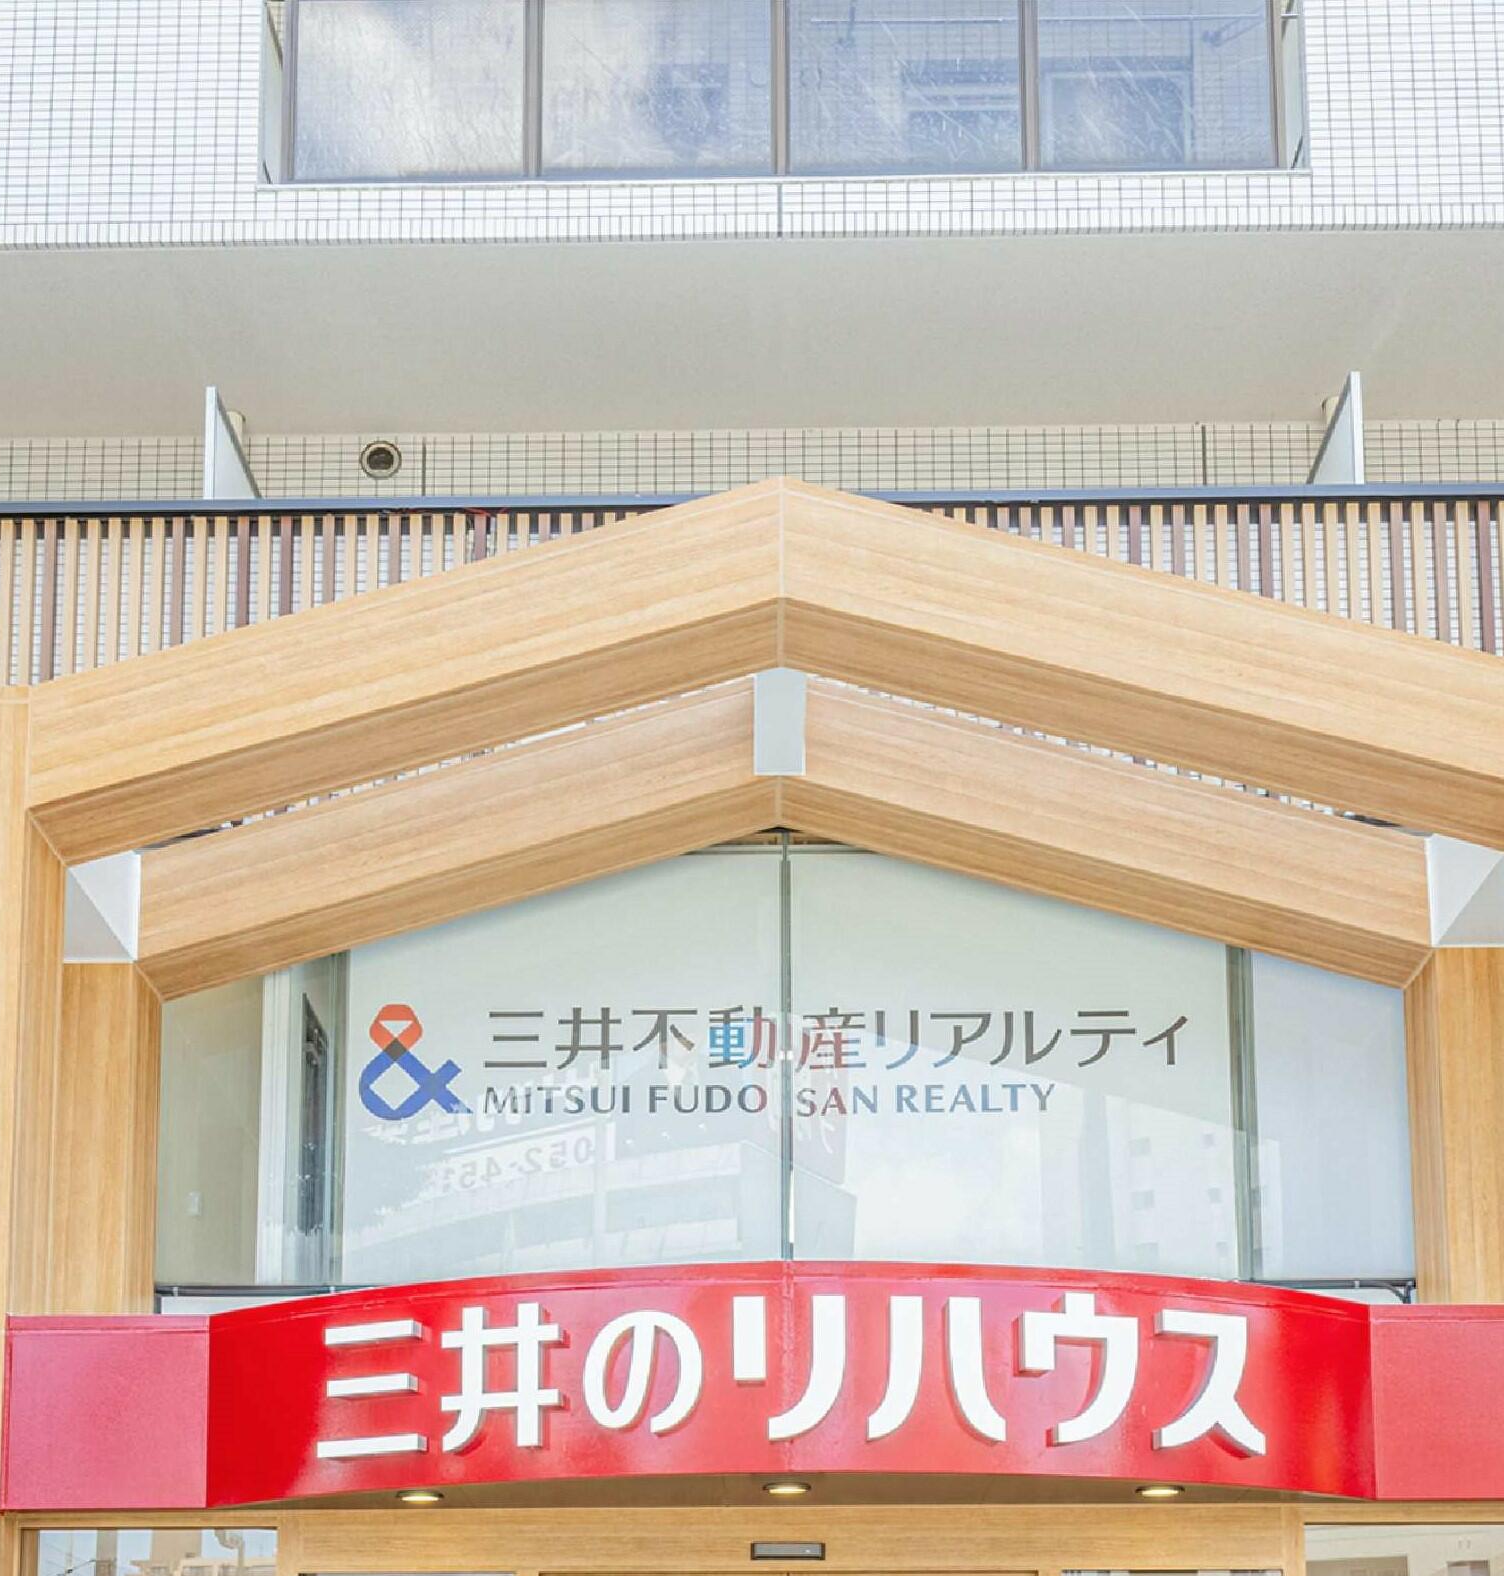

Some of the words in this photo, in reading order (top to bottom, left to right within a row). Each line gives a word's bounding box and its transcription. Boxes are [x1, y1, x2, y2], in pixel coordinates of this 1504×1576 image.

[484, 1006, 1191, 1072] 三井不動産リアルティ
[484, 1082, 634, 1116] MITSUI
[895, 1083, 1057, 1114] REALTY
[316, 1294, 1269, 1461] 三井のリハウス
